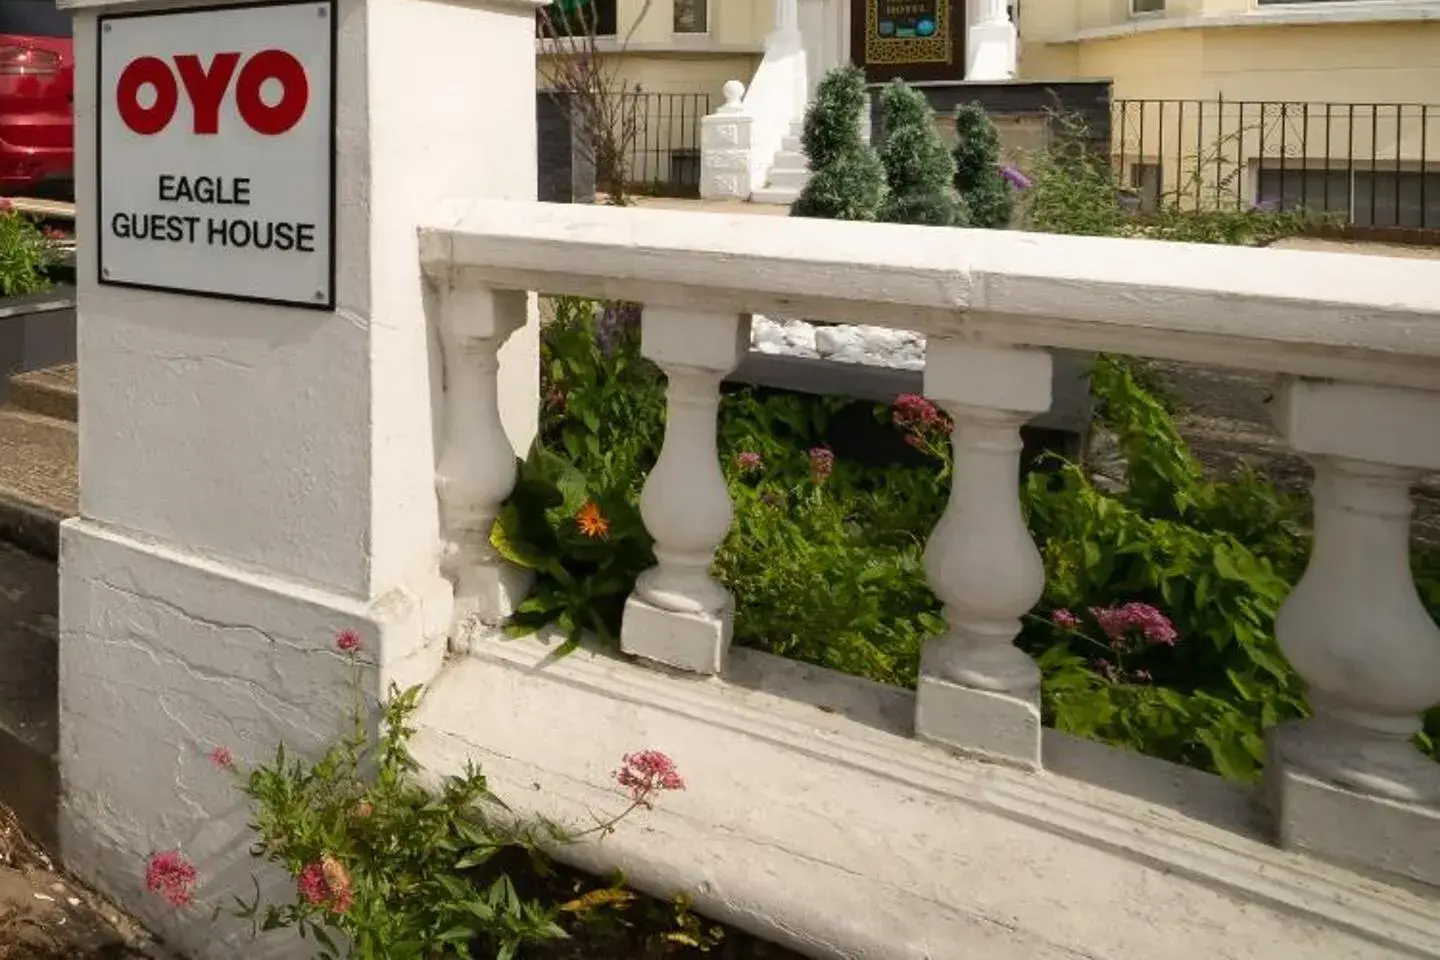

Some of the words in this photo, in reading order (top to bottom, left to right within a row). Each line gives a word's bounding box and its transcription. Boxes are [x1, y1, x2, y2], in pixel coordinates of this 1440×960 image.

[117, 49, 309, 135] OYO
[159, 175, 250, 205] EAGLE
[112, 212, 200, 244] GUEST
[207, 218, 315, 252] HOUSE
